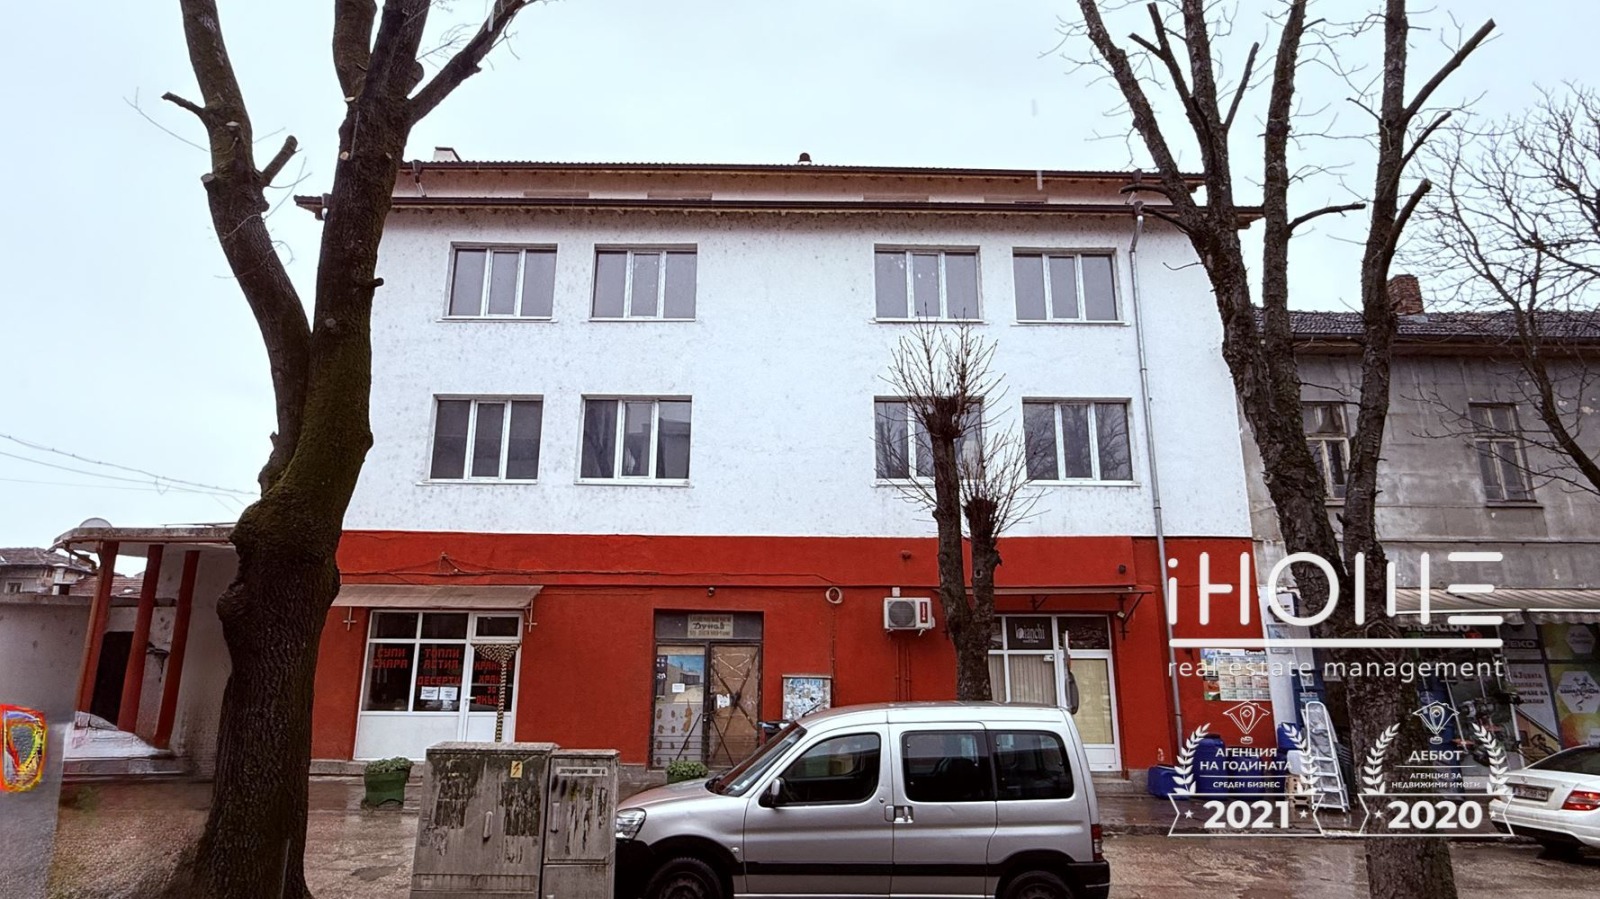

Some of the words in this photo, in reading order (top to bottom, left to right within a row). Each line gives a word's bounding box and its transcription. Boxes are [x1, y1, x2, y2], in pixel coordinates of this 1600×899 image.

[377, 648, 406, 658] СУПИ
[424, 648, 460, 658] ТОПЛИ
[373, 659, 408, 669] СКАРА
[417, 675, 461, 686] ДЕСЕРТИ
